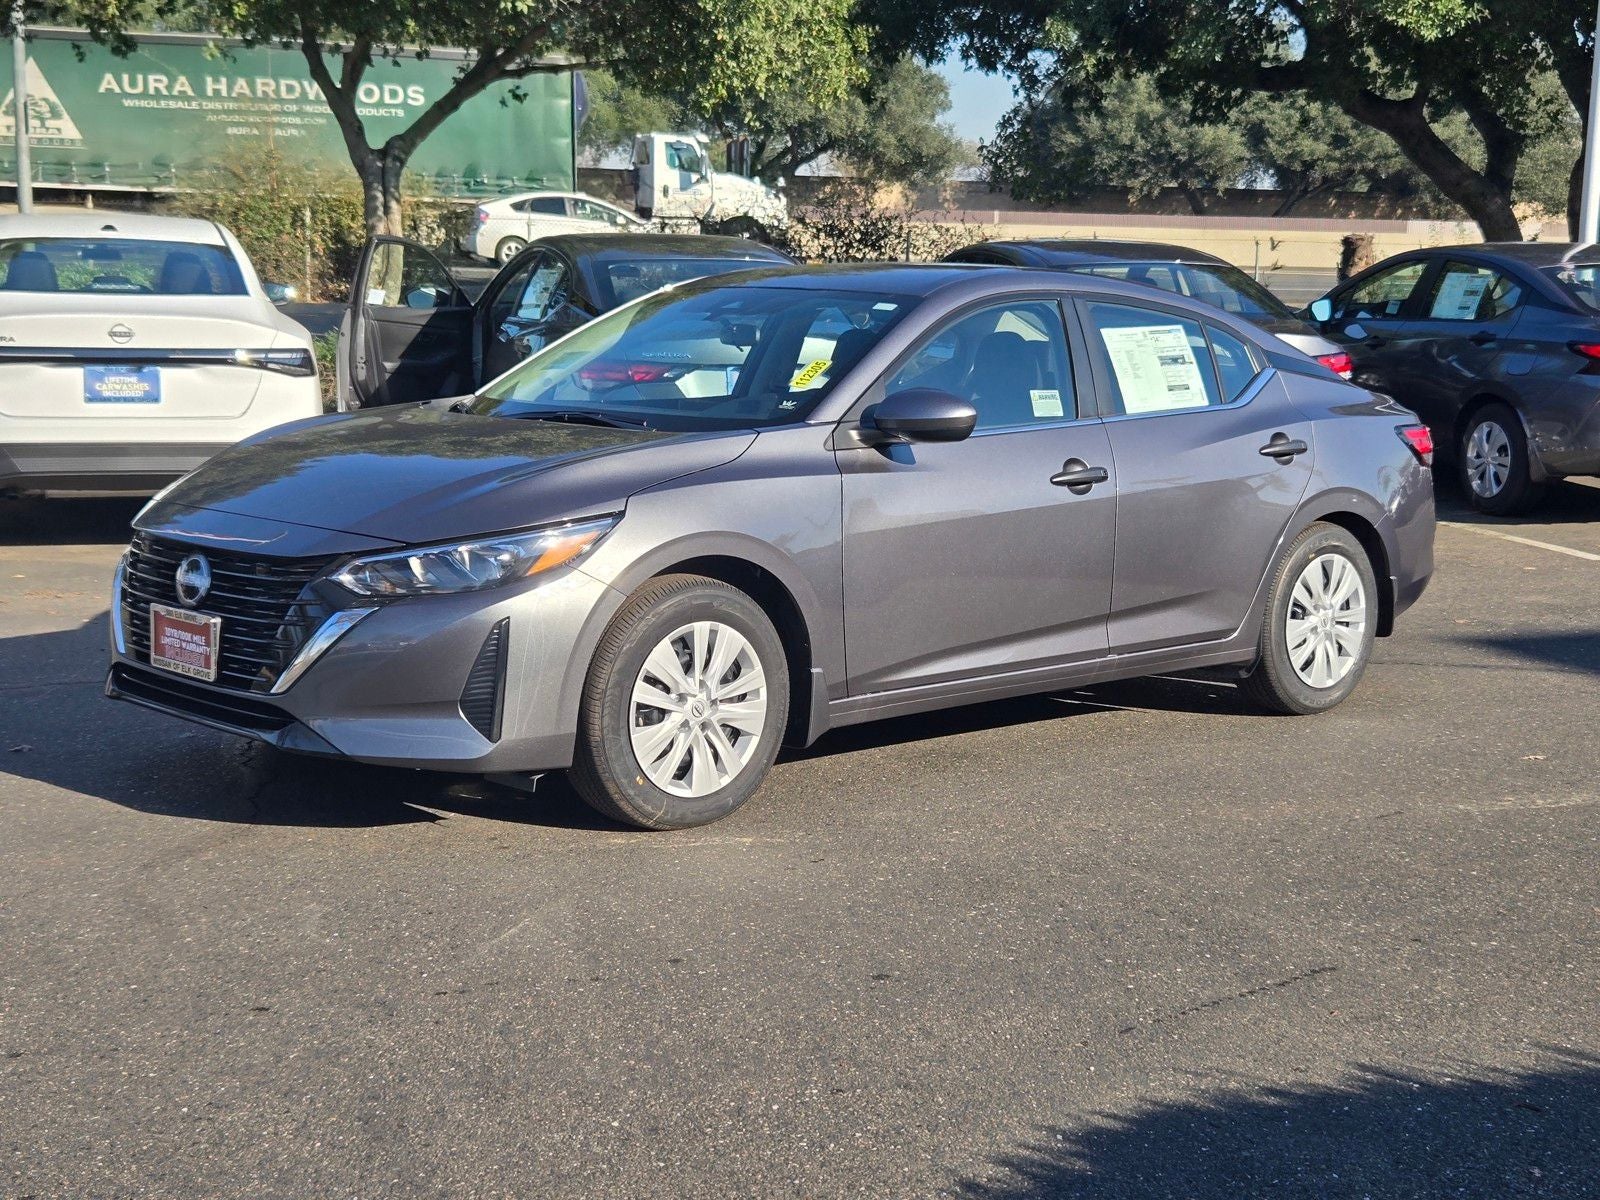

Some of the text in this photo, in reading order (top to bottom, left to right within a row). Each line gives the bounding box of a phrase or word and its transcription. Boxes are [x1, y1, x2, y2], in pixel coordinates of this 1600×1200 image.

[98, 73, 425, 106] AURA HARDWODS
[122, 98, 200, 110] WHOLESALE
[354, 107, 405, 118] ODUCTS
[795, 361, 827, 385] 112305
[95, 383, 150, 391] CARWASHES
[193, 668, 212, 680] GROVE
